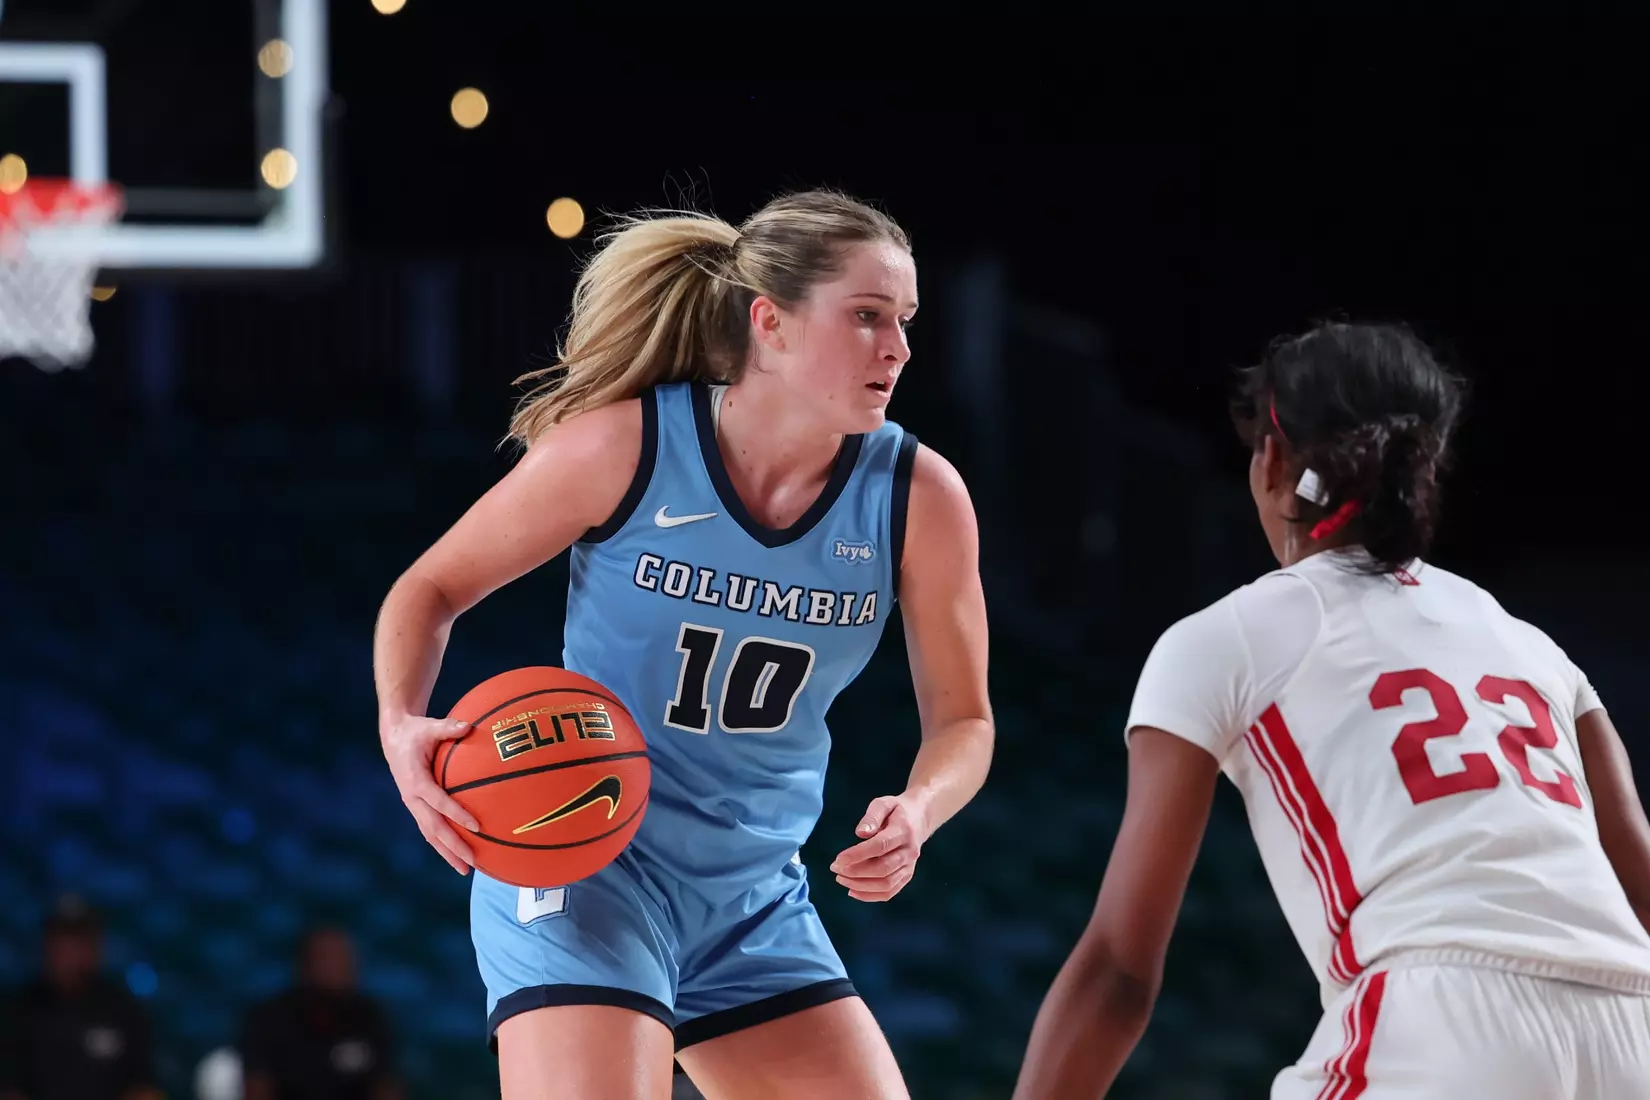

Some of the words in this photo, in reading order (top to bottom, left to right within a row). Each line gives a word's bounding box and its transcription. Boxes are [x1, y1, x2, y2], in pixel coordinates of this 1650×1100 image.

[835, 542, 860, 560] Ivy
[633, 552, 878, 626] COLUMBIA
[663, 622, 816, 735] 10
[493, 710, 616, 762] ELITE
[1368, 667, 1583, 809] 22
